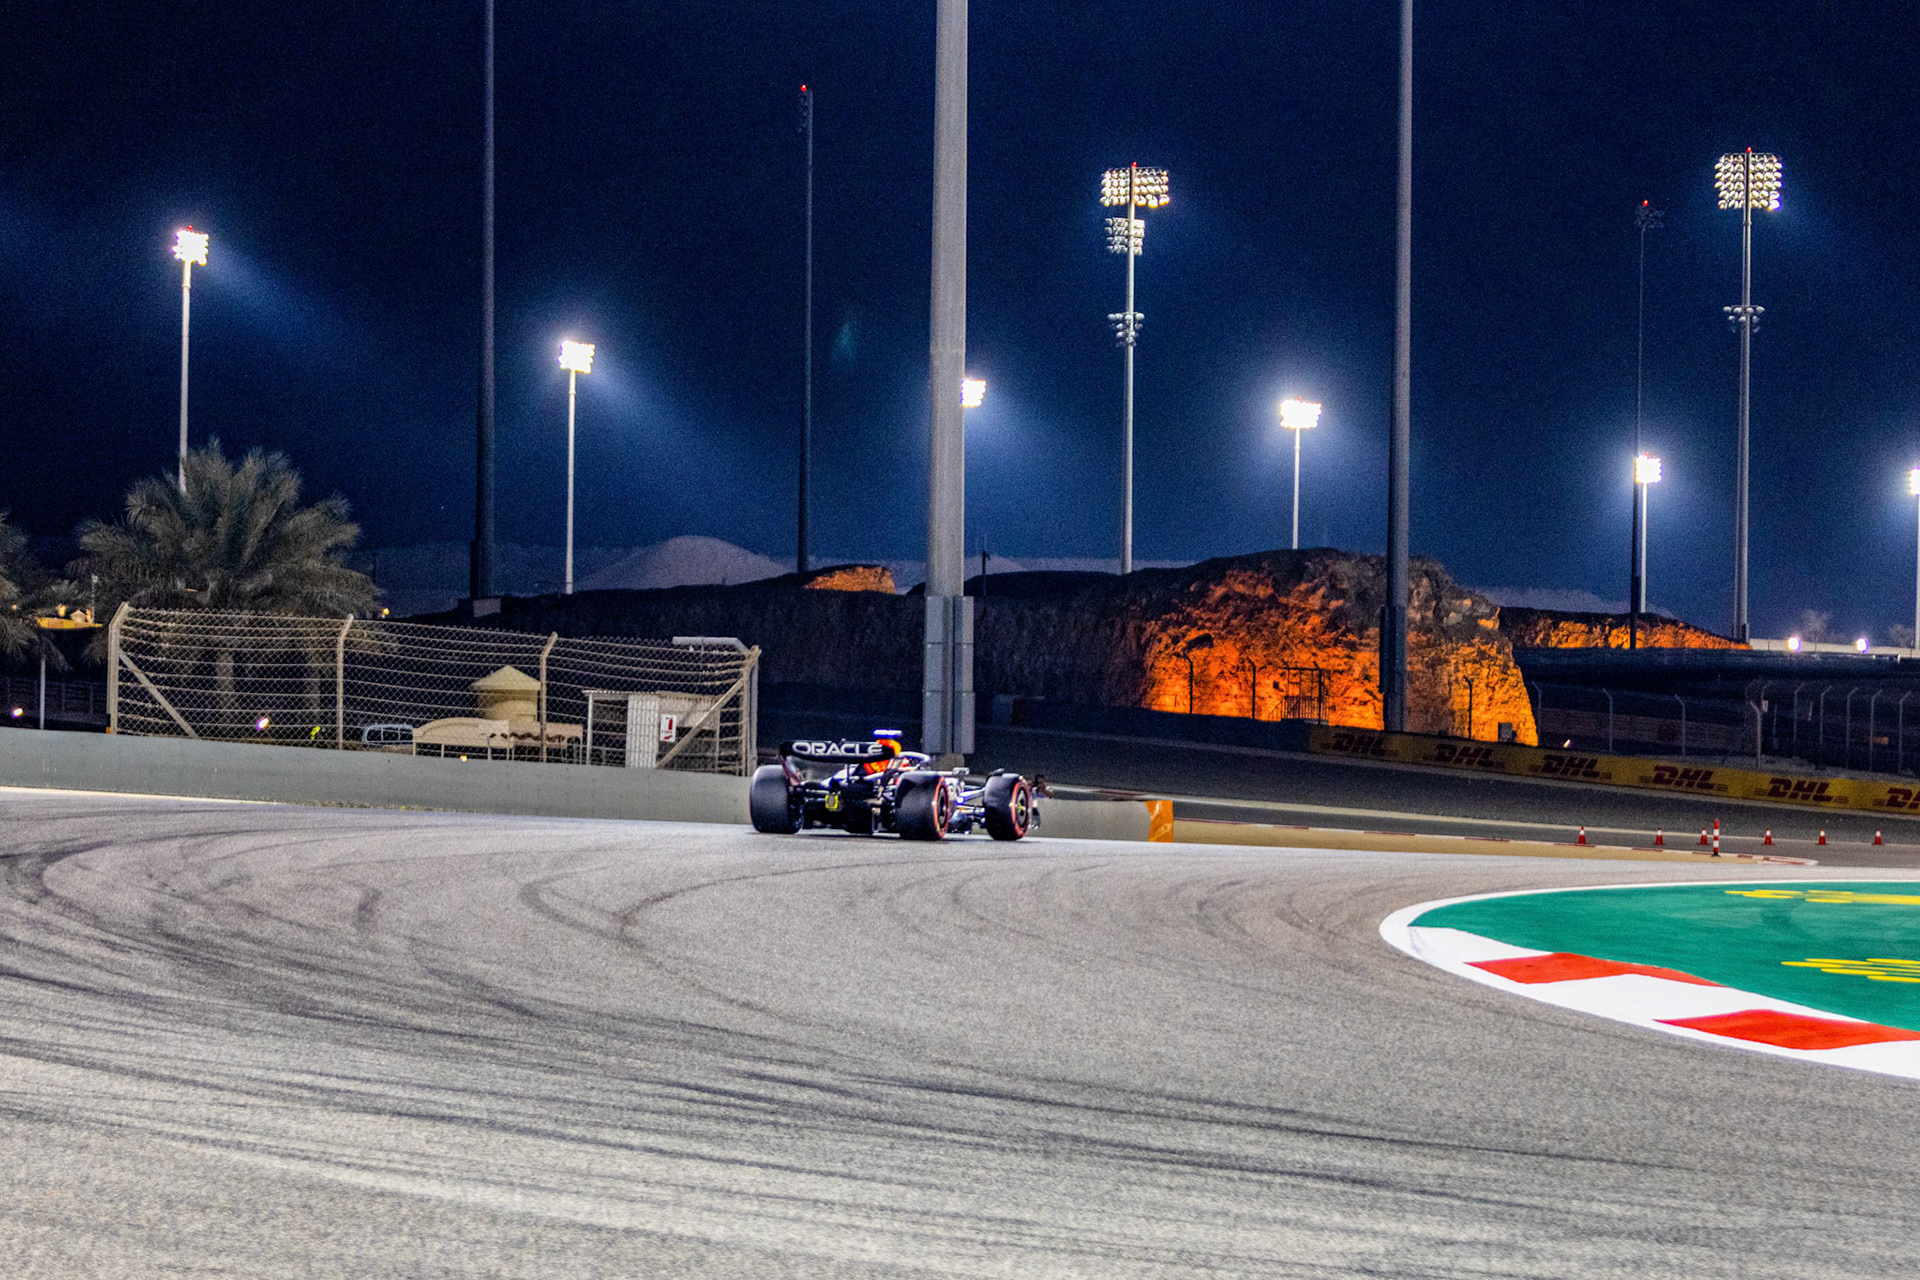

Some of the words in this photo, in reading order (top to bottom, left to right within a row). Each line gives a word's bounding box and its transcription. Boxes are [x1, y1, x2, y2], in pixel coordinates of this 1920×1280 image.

[791, 741, 883, 755] ORACLE
[1434, 743, 1495, 768] DHL
[1540, 754, 1600, 778] DHL
[1652, 765, 1715, 790] DHL
[1766, 777, 1836, 802] DHL
